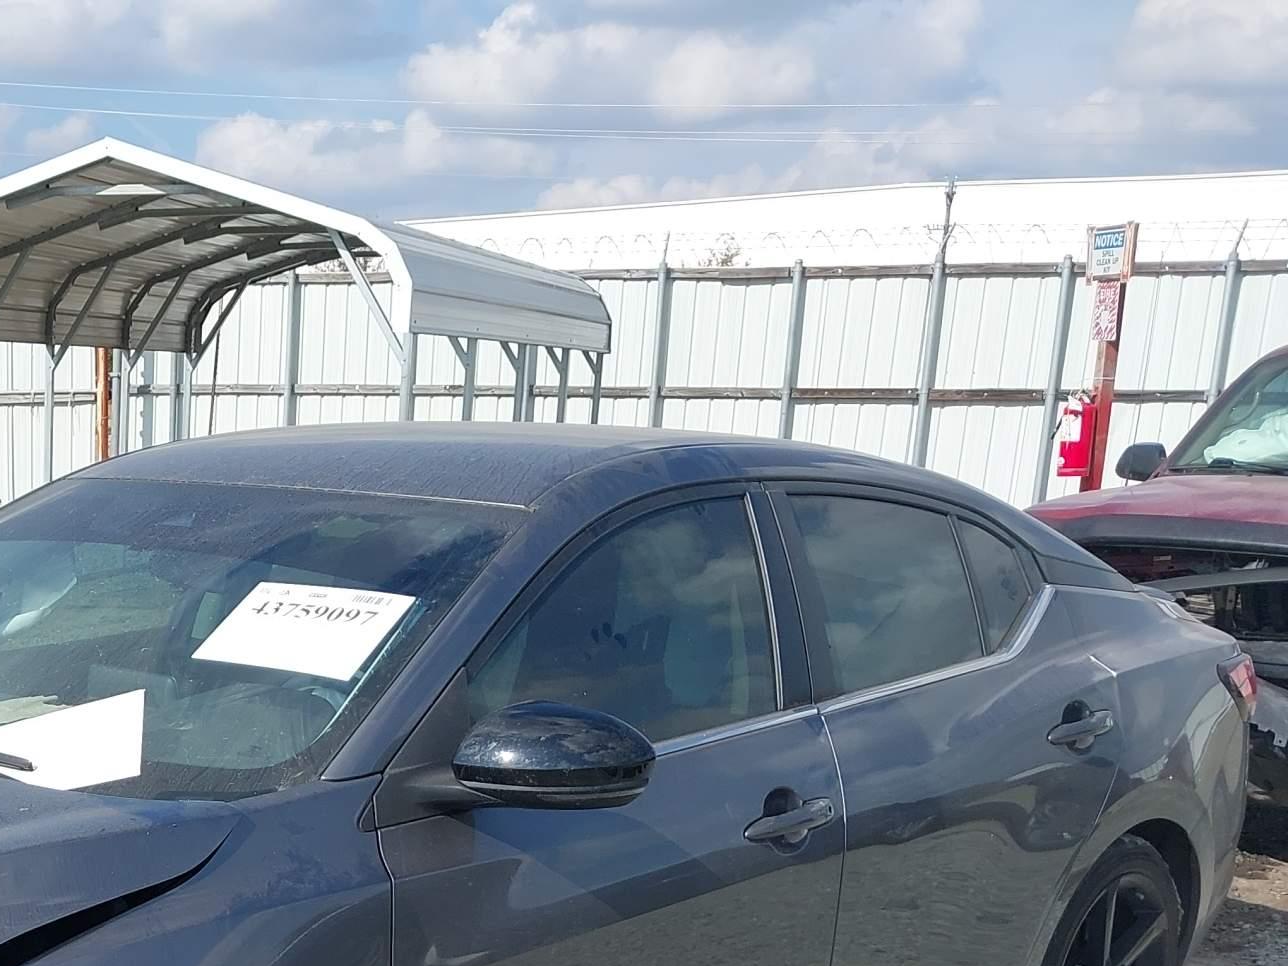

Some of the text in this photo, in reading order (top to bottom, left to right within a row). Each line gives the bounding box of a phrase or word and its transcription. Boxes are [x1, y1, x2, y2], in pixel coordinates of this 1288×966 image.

[1095, 232, 1124, 247] NOTICE
[1096, 258, 1111, 266] CLEAN
[252, 600, 379, 625] 43759097
